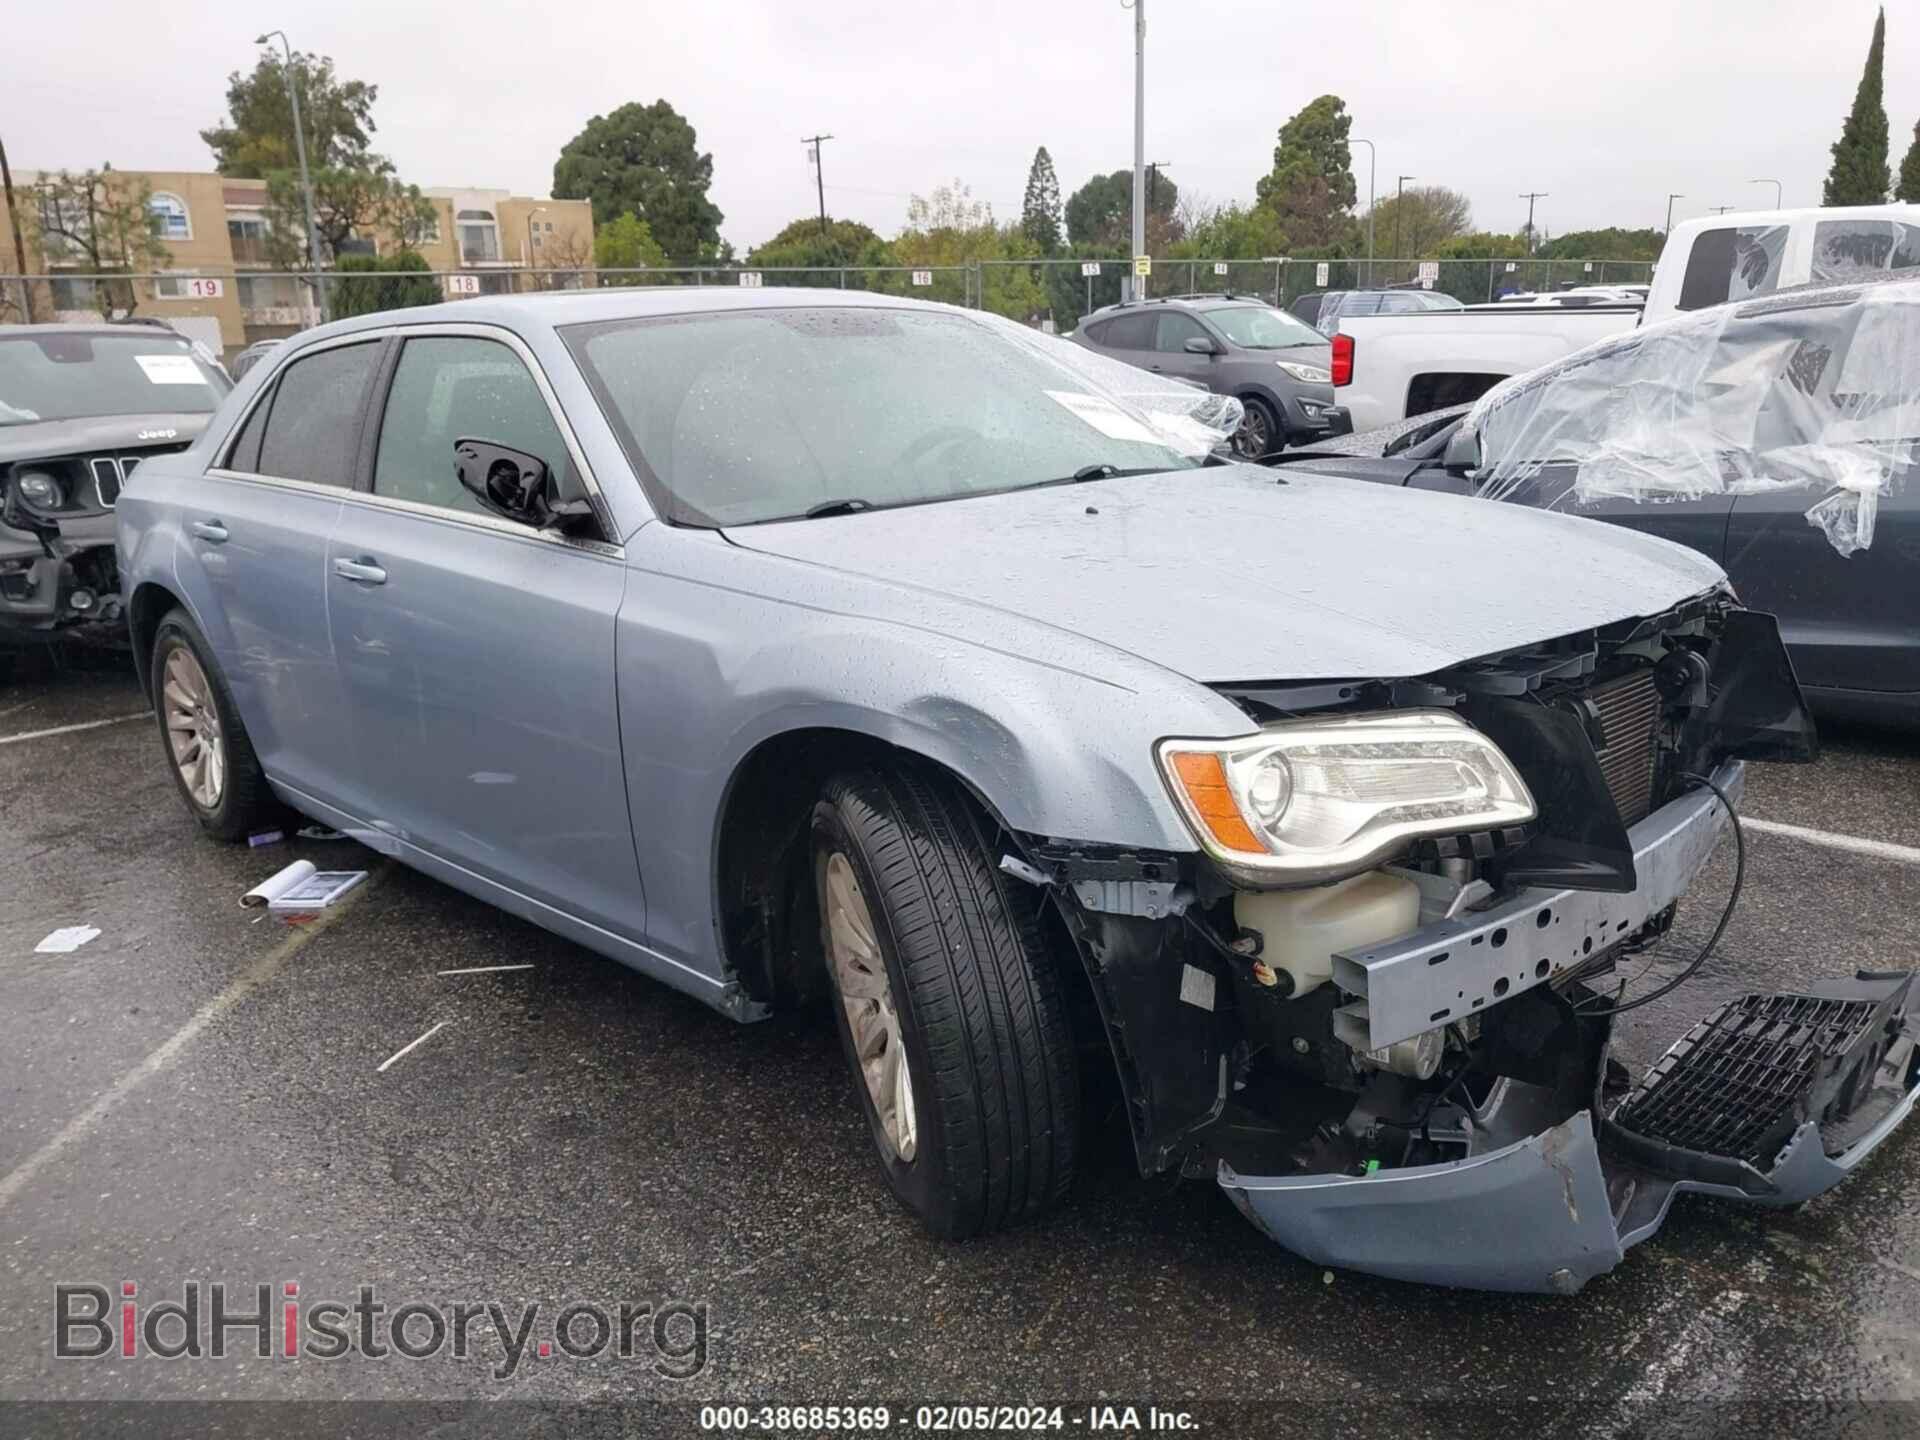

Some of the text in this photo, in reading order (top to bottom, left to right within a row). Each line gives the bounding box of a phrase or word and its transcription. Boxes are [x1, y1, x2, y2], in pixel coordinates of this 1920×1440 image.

[193, 280, 217, 296] 19
[455, 277, 474, 291] 18
[138, 429, 176, 439] Jeep
